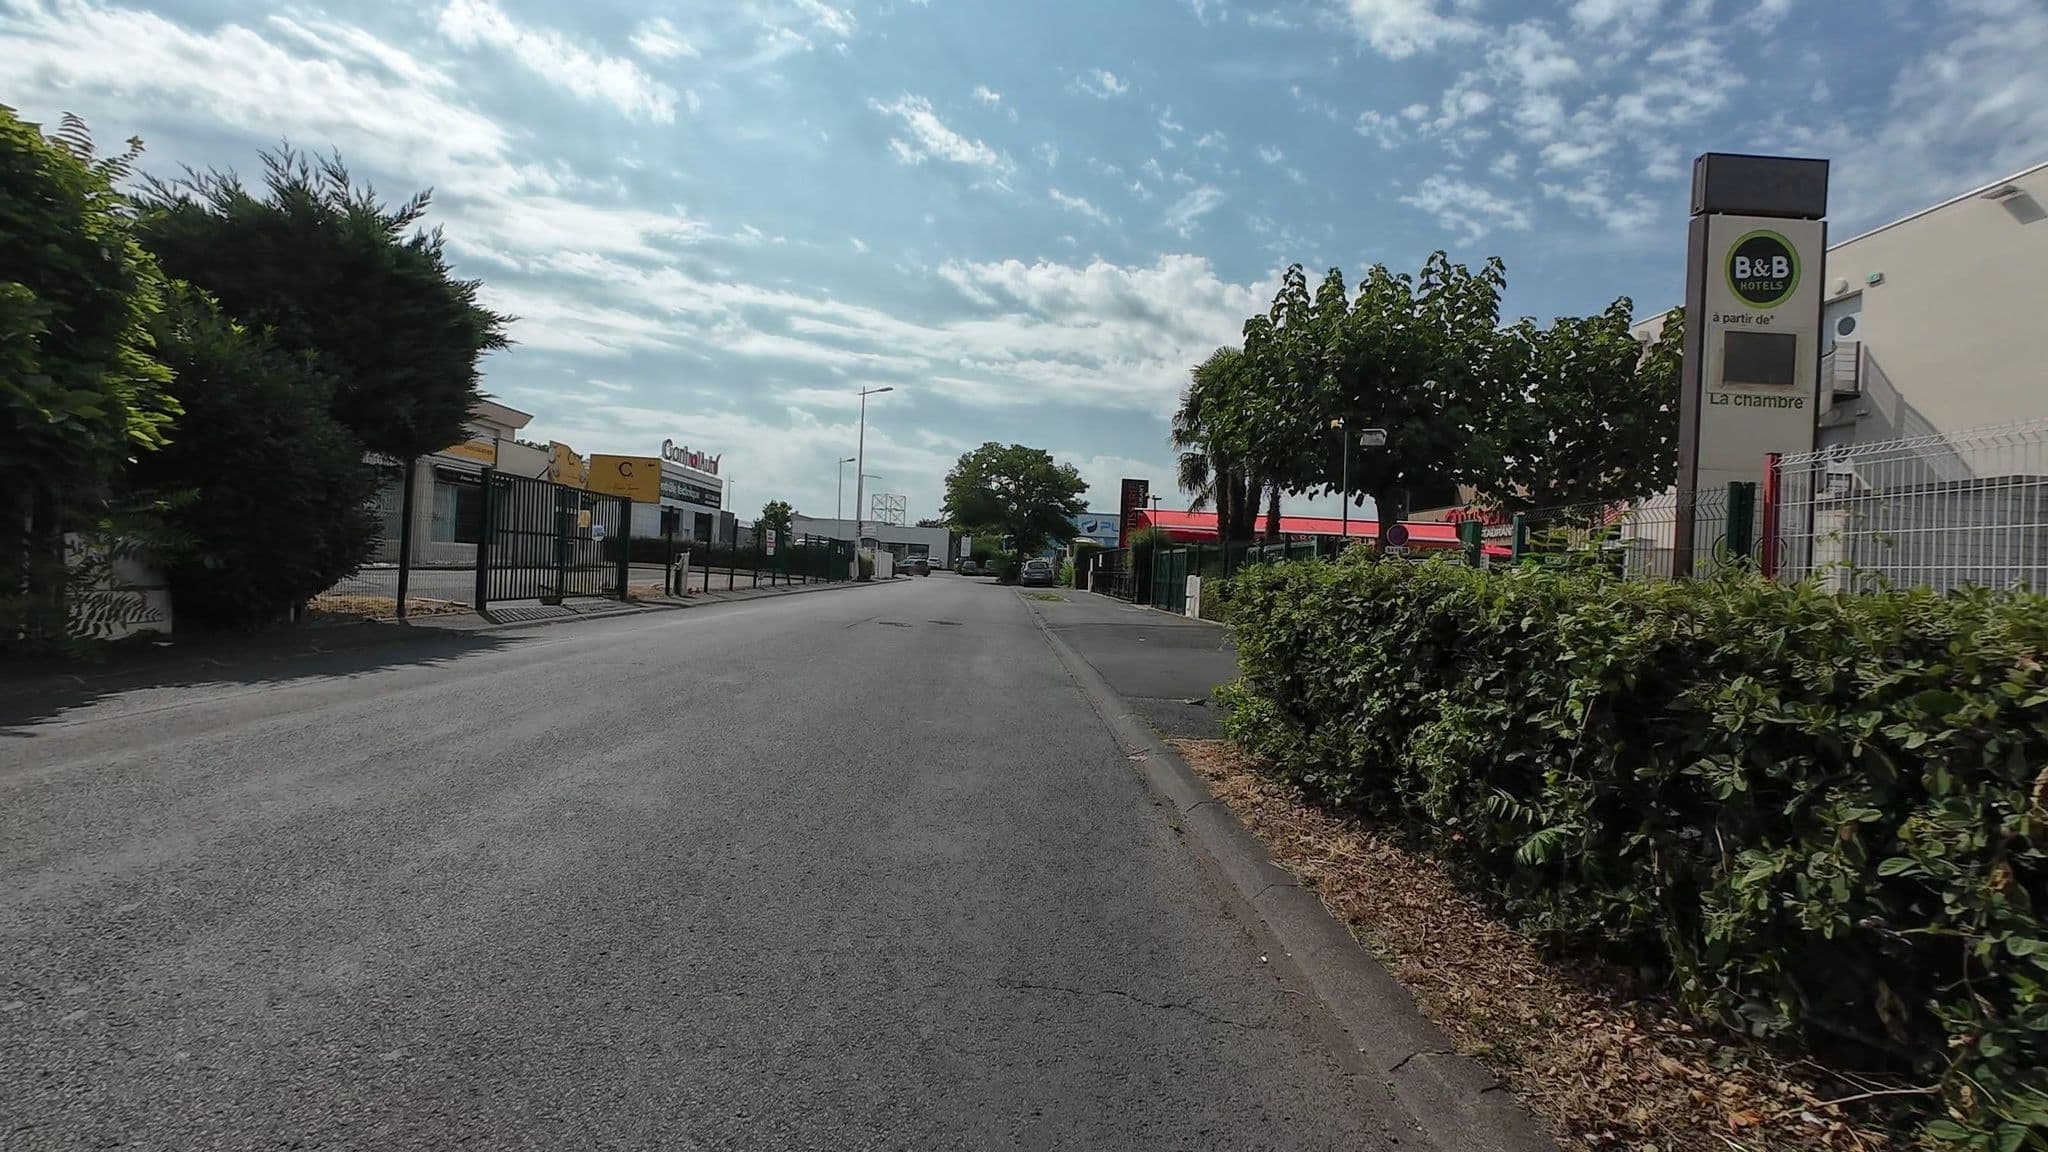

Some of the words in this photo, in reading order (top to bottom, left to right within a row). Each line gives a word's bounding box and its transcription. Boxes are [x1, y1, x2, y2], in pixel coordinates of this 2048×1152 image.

[1735, 255, 1790, 279] B&B
[1740, 280, 1784, 291] HOTELS
[1722, 313, 1752, 324] partir
[1709, 392, 1729, 405] La
[1733, 394, 1804, 409] chambre
[1100, 521, 1119, 532] PL
